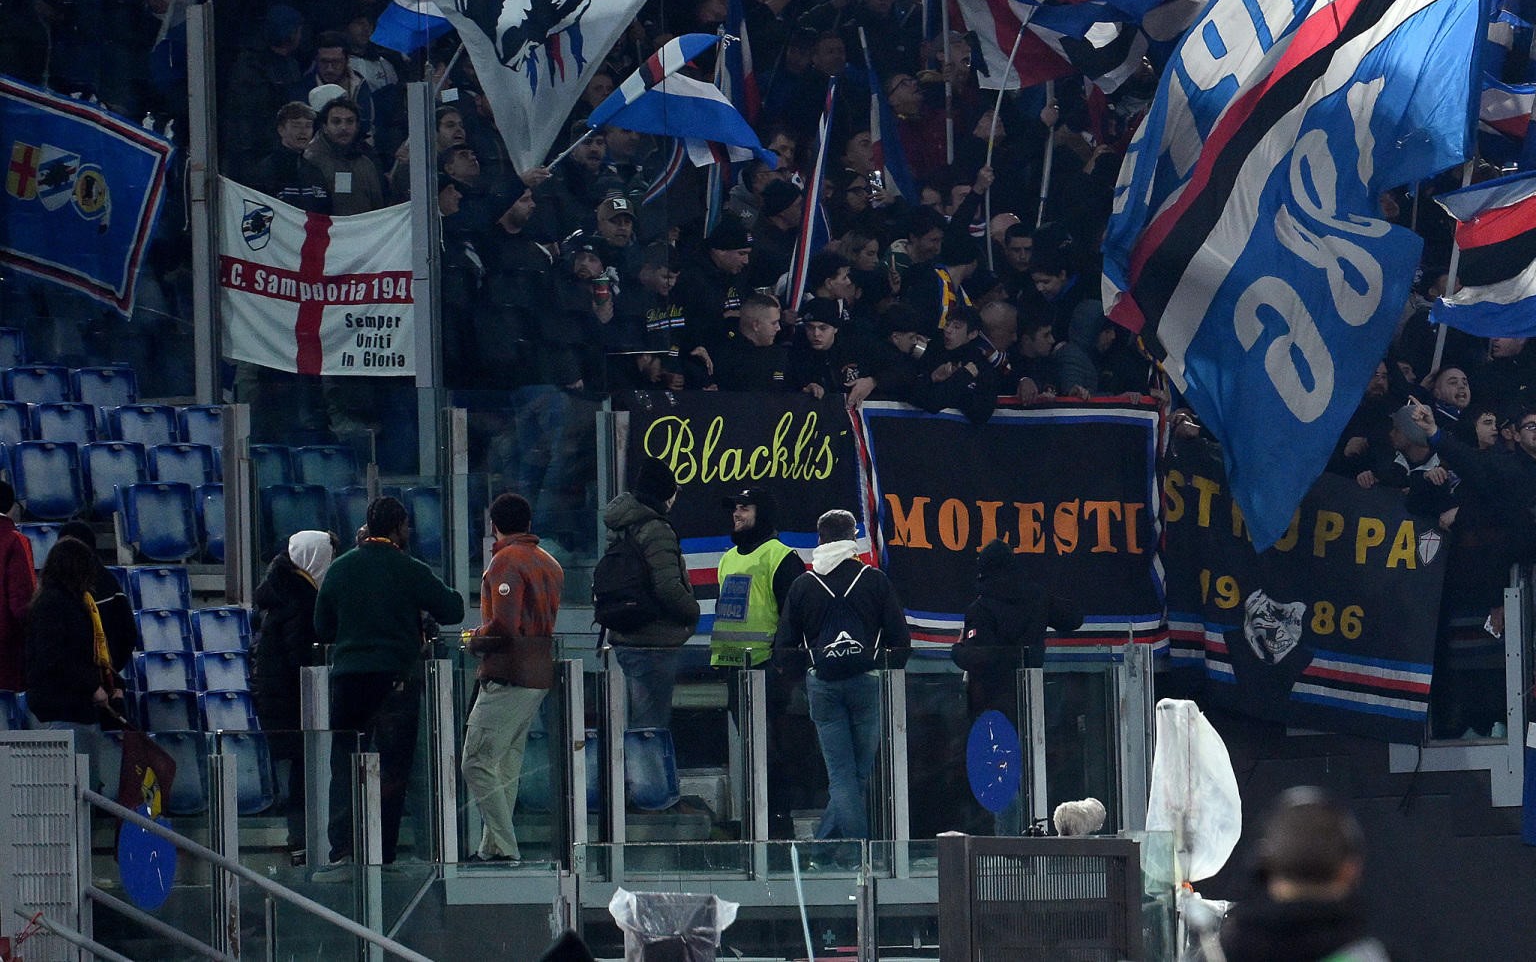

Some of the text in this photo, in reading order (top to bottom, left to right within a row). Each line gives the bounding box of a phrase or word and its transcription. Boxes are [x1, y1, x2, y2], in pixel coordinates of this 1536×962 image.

[371, 277, 415, 301] 194
[345, 312, 402, 331] Semper
[356, 334, 391, 349] Uniti
[643, 411, 847, 485] Blacklis
[885, 492, 1145, 556] MOLESTI
[1310, 600, 1365, 640] 86
